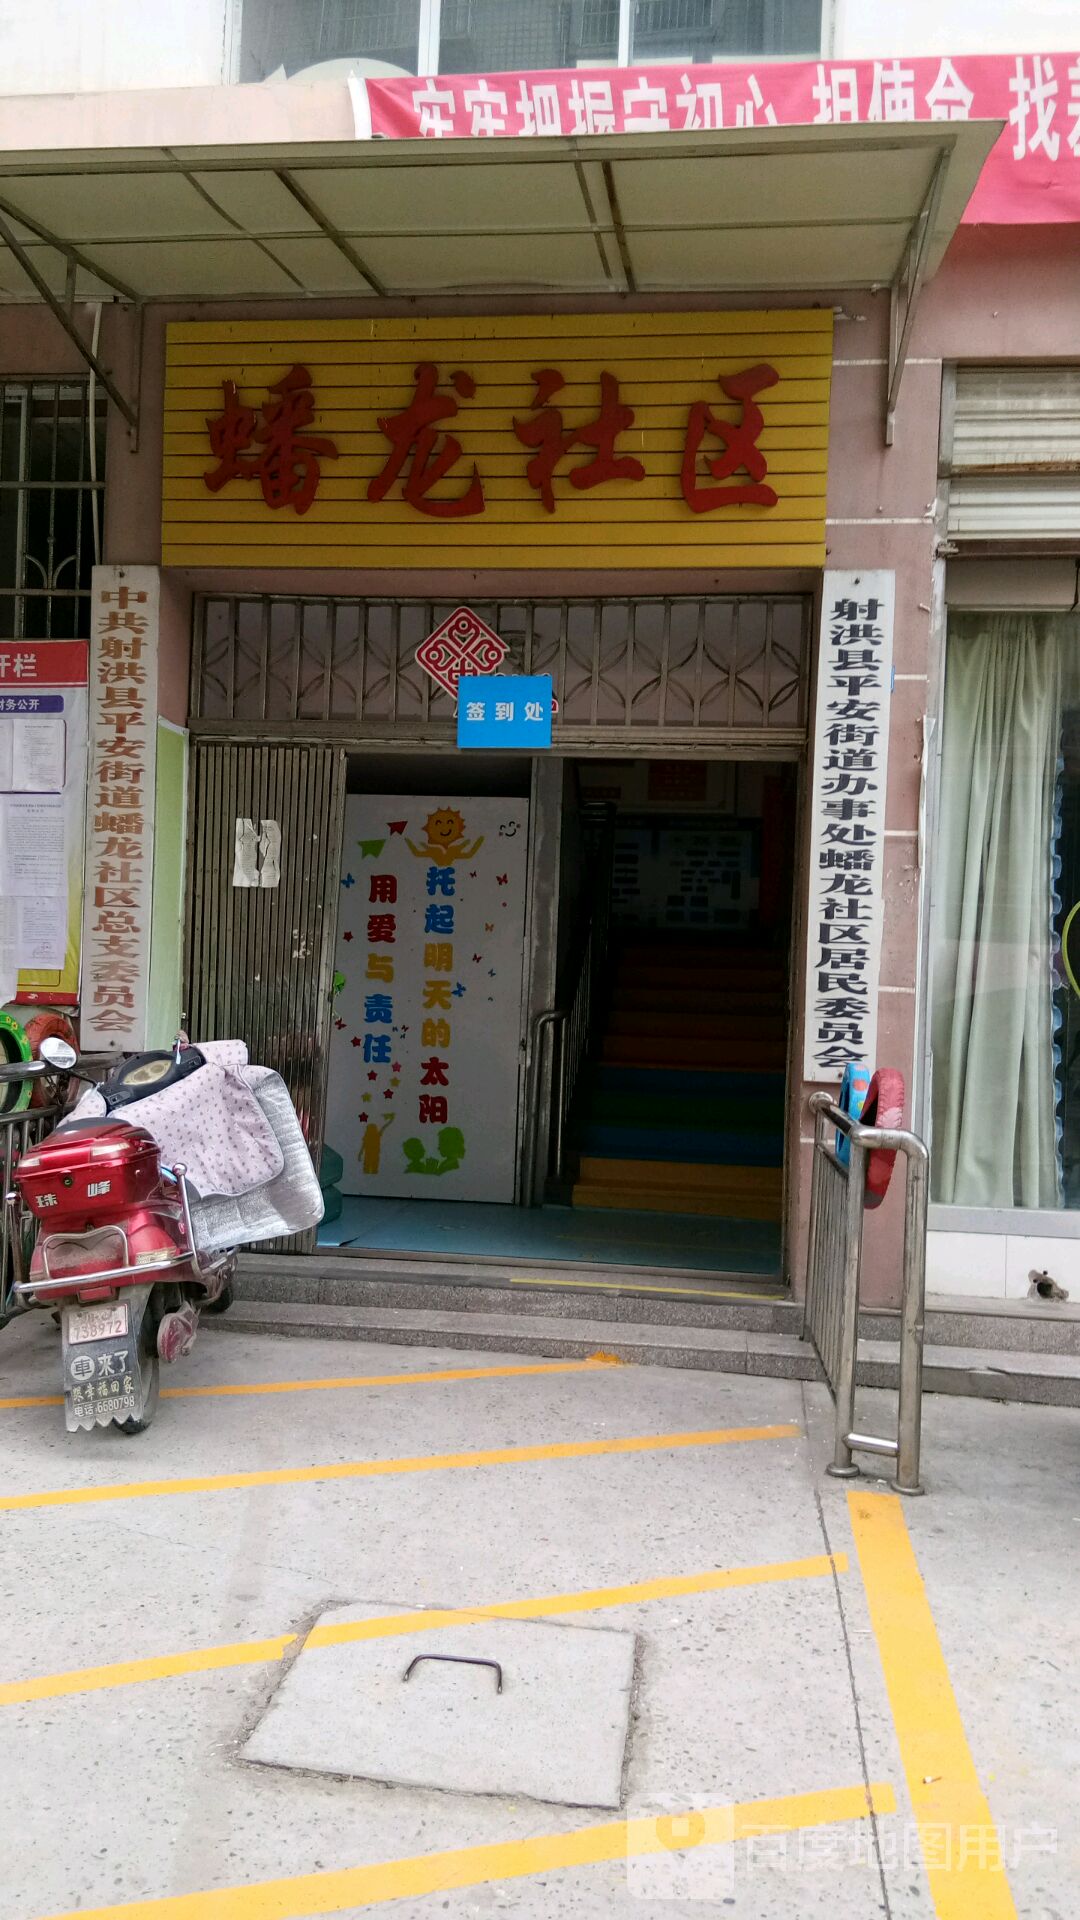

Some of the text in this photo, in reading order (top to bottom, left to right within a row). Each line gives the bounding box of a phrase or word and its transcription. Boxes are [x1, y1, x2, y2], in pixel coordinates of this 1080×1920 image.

[1009, 55, 1080, 161] 找
[204, 362, 779, 518] 蟠龙社区
[466, 702, 543, 721] 签到处
[87, 586, 149, 1033] 中共射洪县平安街道蟠龙社区总支委员会
[812, 597, 885, 1068] 射洪县平安街道办事处蟠龙社区居民委员会
[363, 874, 398, 1064] 用爱与责任
[418, 866, 455, 1124] 托起明天的太阳
